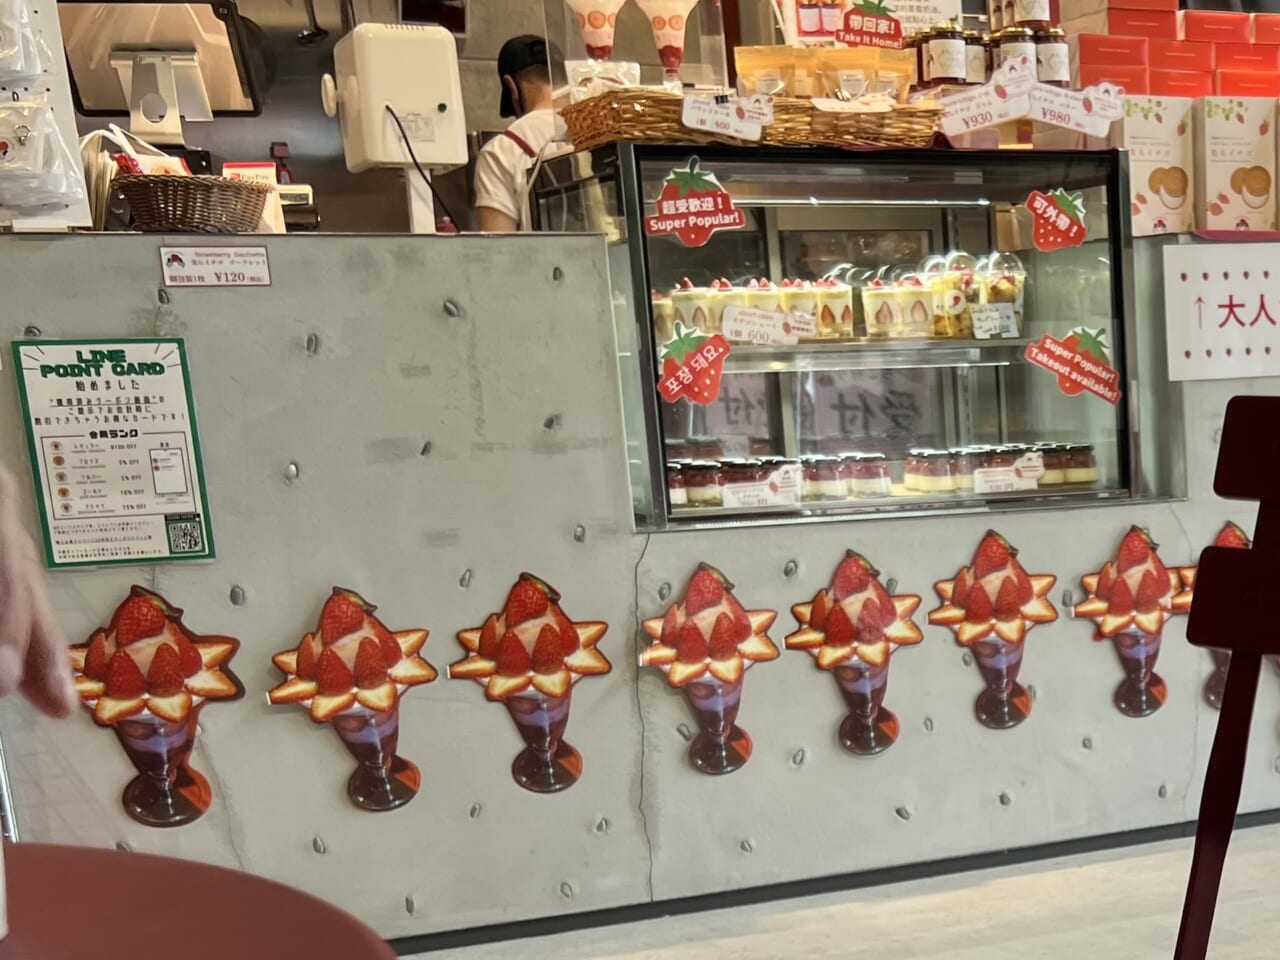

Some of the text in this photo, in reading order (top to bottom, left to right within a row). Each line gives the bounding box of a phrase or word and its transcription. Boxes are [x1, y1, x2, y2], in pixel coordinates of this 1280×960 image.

[838, 31, 903, 49] Take It Home!
[962, 111, 993, 129] ¥930
[1041, 107, 1071, 125] ¥980
[650, 211, 740, 231] Super Popular!
[214, 272, 245, 283] ¥120
[747, 330, 770, 343] 600
[76, 350, 127, 364] LINE
[1043, 338, 1116, 382] Super Popular!
[40, 362, 166, 378] POINT CARD
[1031, 347, 1118, 400] Takeout available!
[75, 379, 140, 392] 始めました
[665, 366, 693, 395] 포장
